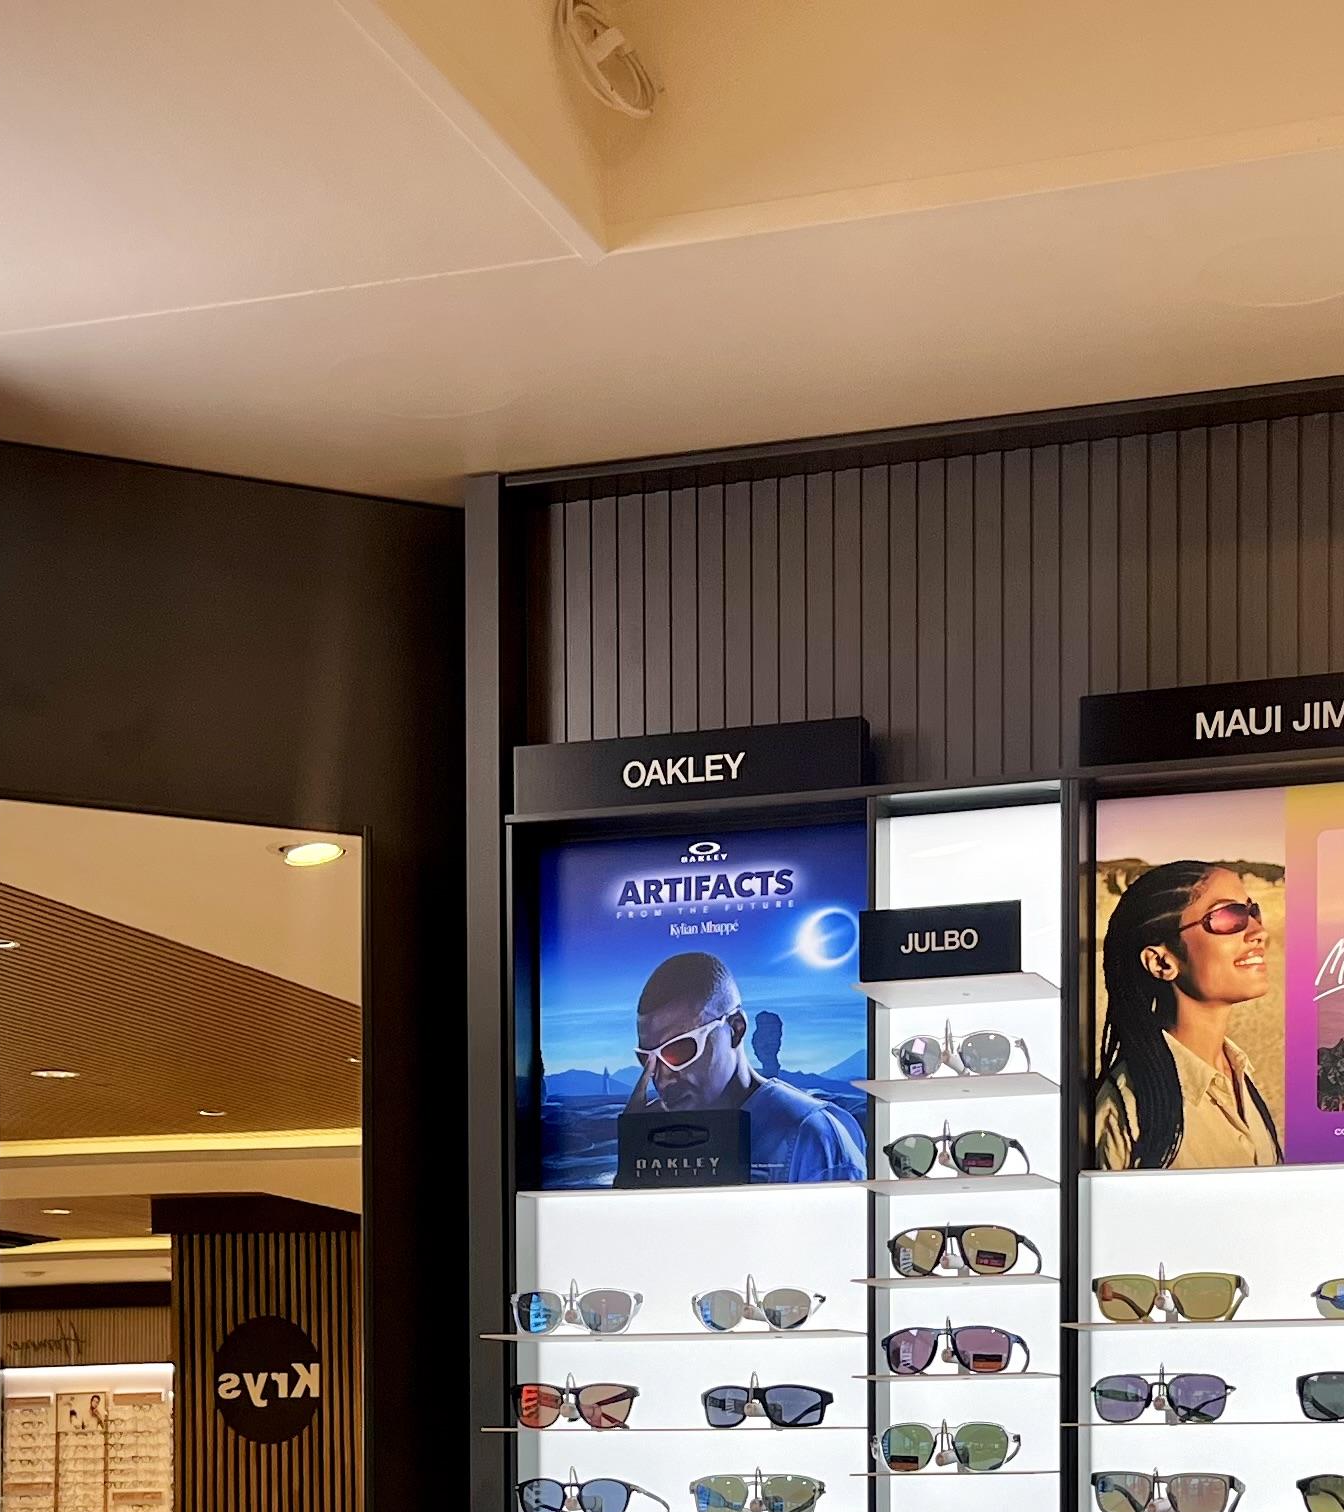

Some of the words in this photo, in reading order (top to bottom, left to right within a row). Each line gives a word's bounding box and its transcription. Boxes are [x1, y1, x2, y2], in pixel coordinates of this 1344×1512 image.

[1195, 704, 1282, 740] MAUI
[622, 751, 746, 789] OAKLEY
[680, 852, 728, 863] OAKLEY
[617, 868, 794, 907] ARTIFACTS
[616, 908, 662, 920] FROM
[677, 905, 709, 915] THE
[724, 899, 795, 912] FUTURE
[669, 922, 699, 939] Kylian
[700, 919, 740, 937] Mbappé
[900, 928, 979, 954] JULBO
[636, 1156, 720, 1170] OAKLEY
